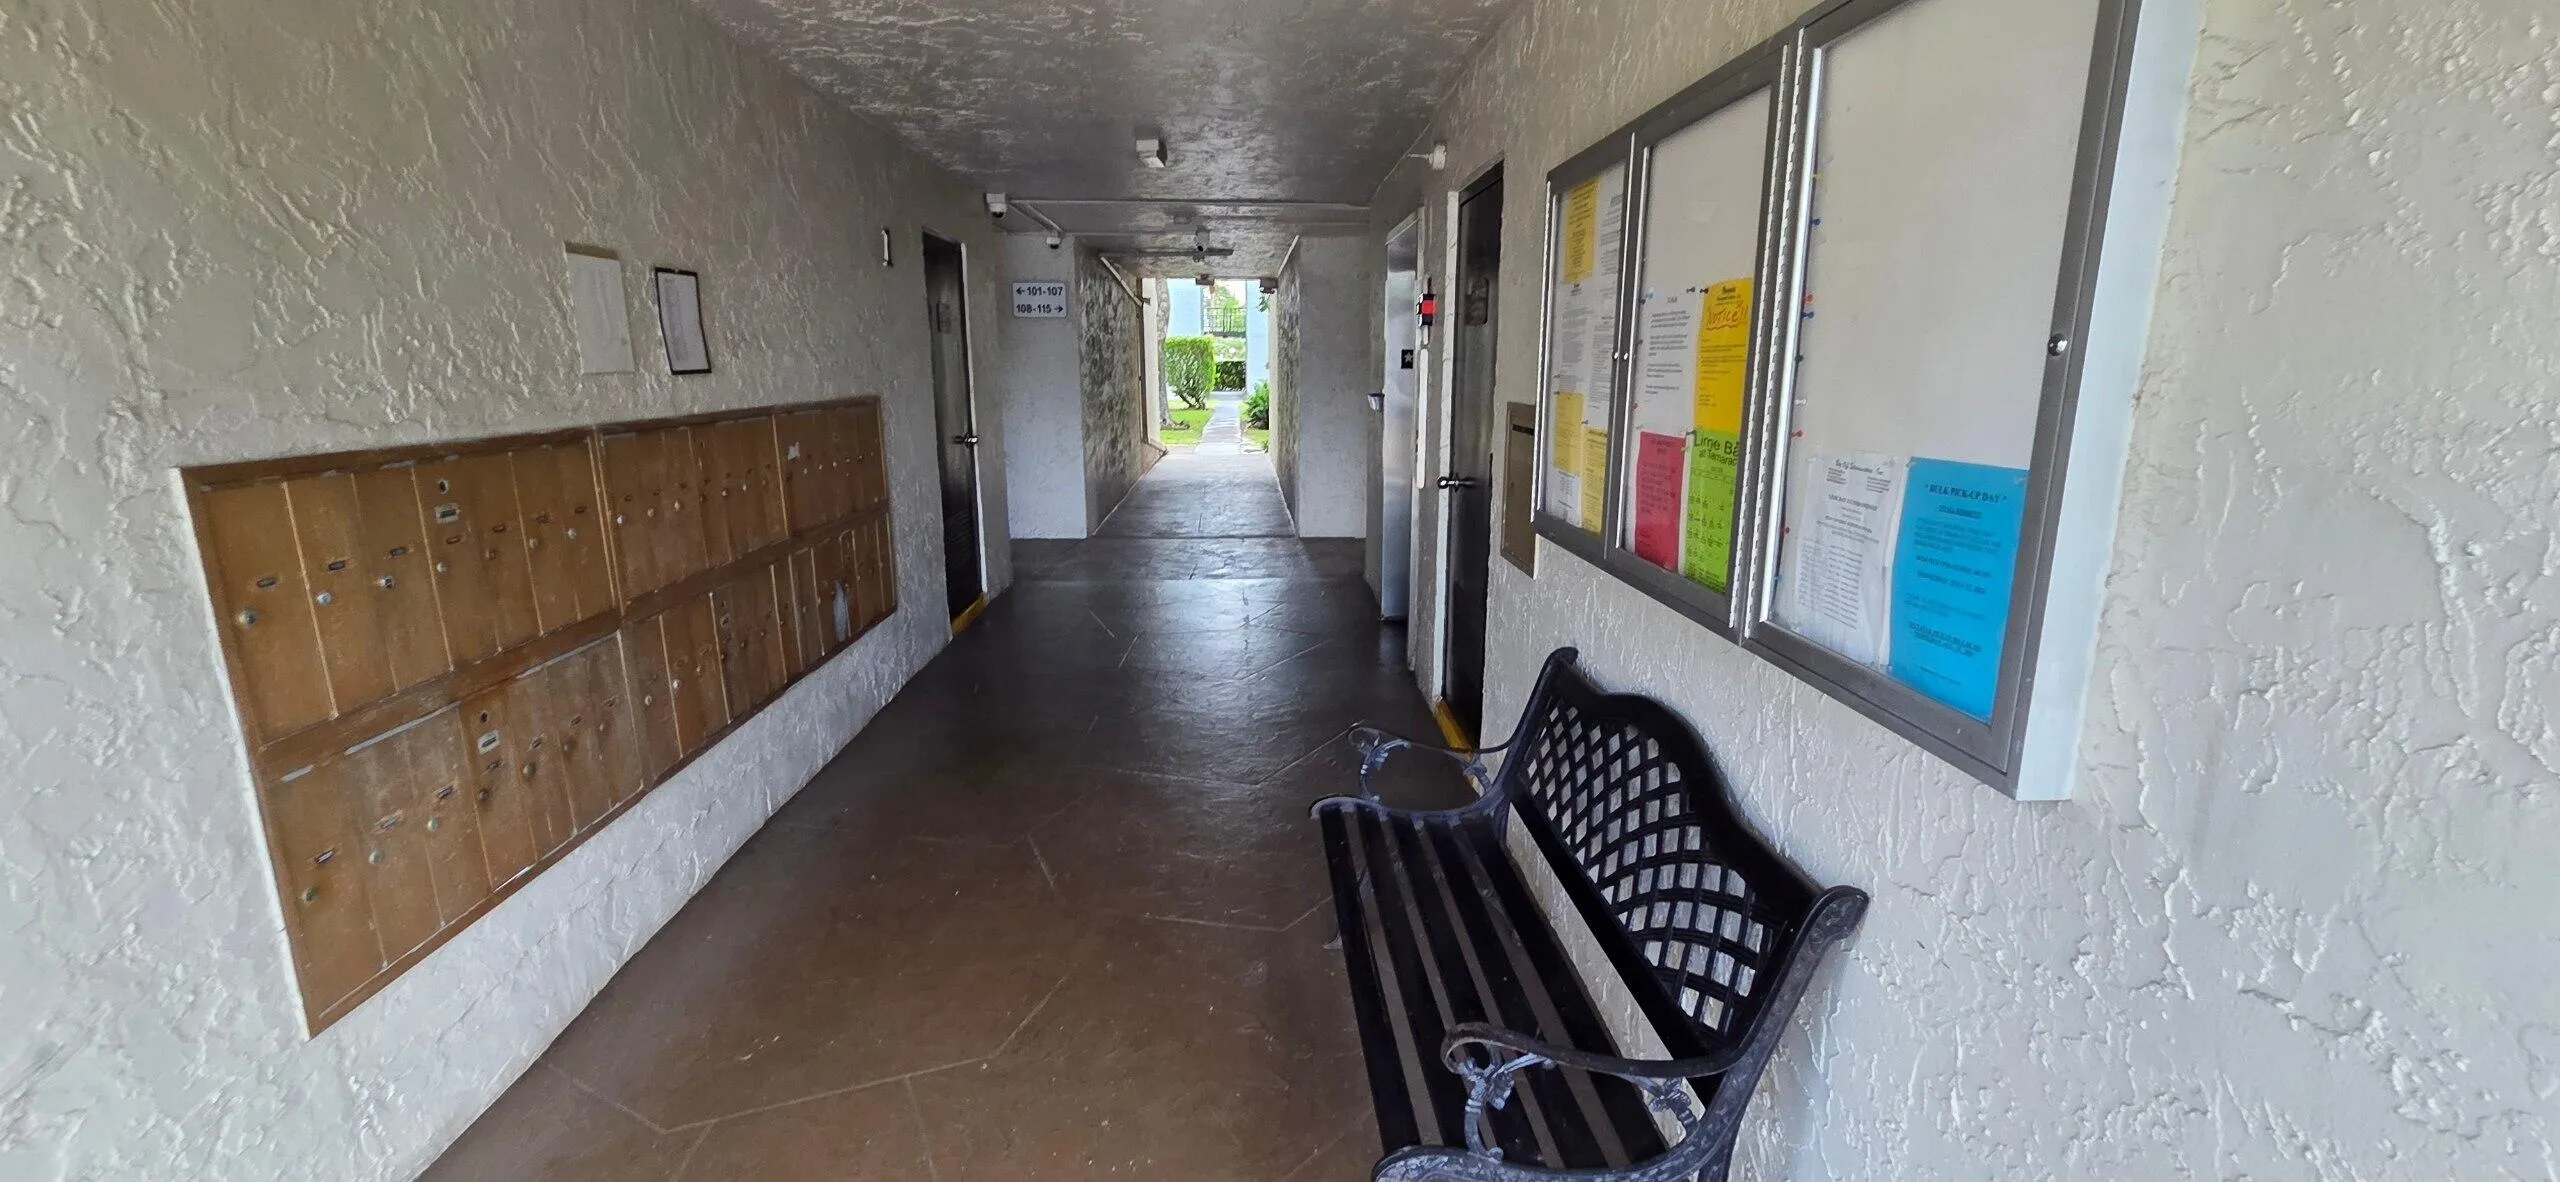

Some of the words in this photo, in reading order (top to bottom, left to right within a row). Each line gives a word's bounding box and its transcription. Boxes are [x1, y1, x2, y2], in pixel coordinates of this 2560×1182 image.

[1027, 286, 1063, 296] 101-107
[1016, 303, 1052, 314] 108-115
[1694, 430, 1721, 451] Lime
[1980, 492, 2001, 504] DAY
